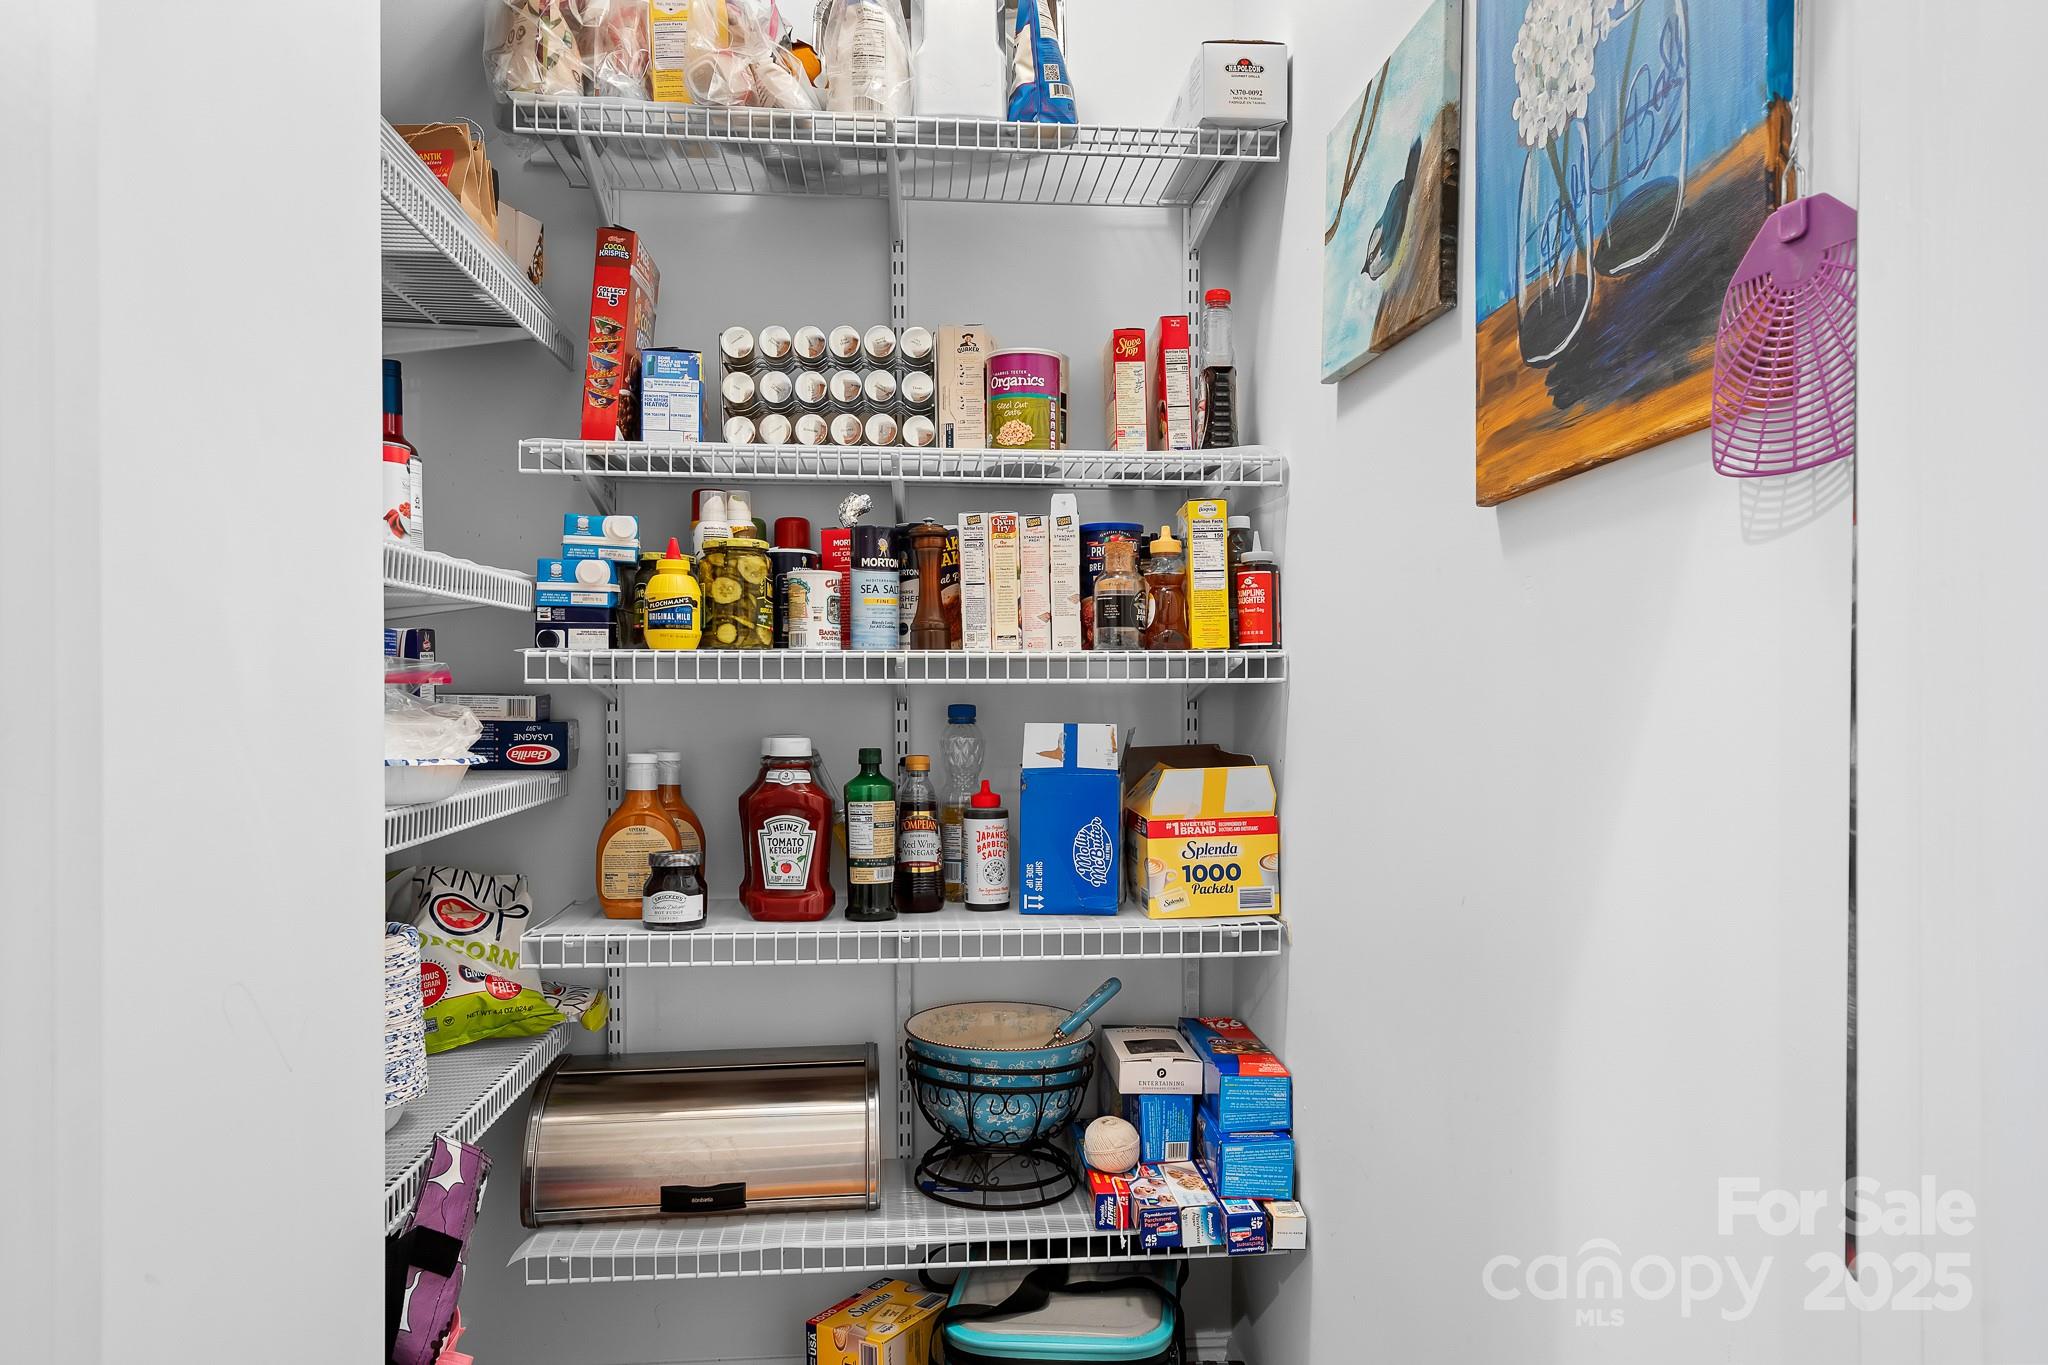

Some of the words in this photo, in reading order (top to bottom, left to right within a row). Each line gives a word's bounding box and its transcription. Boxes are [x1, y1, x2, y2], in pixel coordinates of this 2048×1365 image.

[1228, 64, 1261, 73] NAPOLEON
[1230, 88, 1263, 96] N370-0092
[604, 242, 626, 252] COCOA
[599, 250, 630, 260] KRISPIES
[598, 286, 627, 294] COLLECT
[608, 294, 618, 306] 5
[956, 346, 980, 354] QUAKER
[1116, 338, 1142, 354] Stove
[1126, 346, 1138, 358] Top
[991, 374, 1045, 390] Organics
[992, 517, 1014, 526] Oven
[861, 558, 899, 568] MORTON
[860, 584, 879, 594] SEA
[884, 585, 899, 594] SALT
[650, 598, 690, 608] PLOCHMAN'S
[649, 612, 675, 620] ORIGINAL
[676, 612, 691, 620] MILD
[514, 733, 553, 741] LASAGNE
[512, 749, 548, 760] Barilla
[773, 824, 799, 832] HEINZ
[1166, 822, 1179, 835] #1
[1180, 826, 1216, 835] BRAND
[768, 838, 804, 846] TOMATO
[902, 840, 916, 848] Red
[917, 840, 936, 848] Wine
[982, 849, 1006, 860] SAUCE
[1076, 828, 1088, 876] Molly
[1090, 816, 1107, 888] McButter
[1182, 840, 1238, 859] Splenda
[1026, 864, 1034, 878] SIDE
[1182, 863, 1242, 883] 1000
[1026, 879, 1034, 889] UP
[1192, 883, 1234, 894] Packets
[424, 979, 441, 988] GRAIN
[491, 981, 519, 994] FREE
[466, 1010, 479, 1020] NET
[1207, 1020, 1242, 1029] 166
[1208, 1212, 1216, 1240] Reynolds
[1251, 1221, 1263, 1229] 45
[1145, 1234, 1157, 1242] 45
[848, 1292, 894, 1318] Splenda
[811, 1309, 837, 1323] 1000
